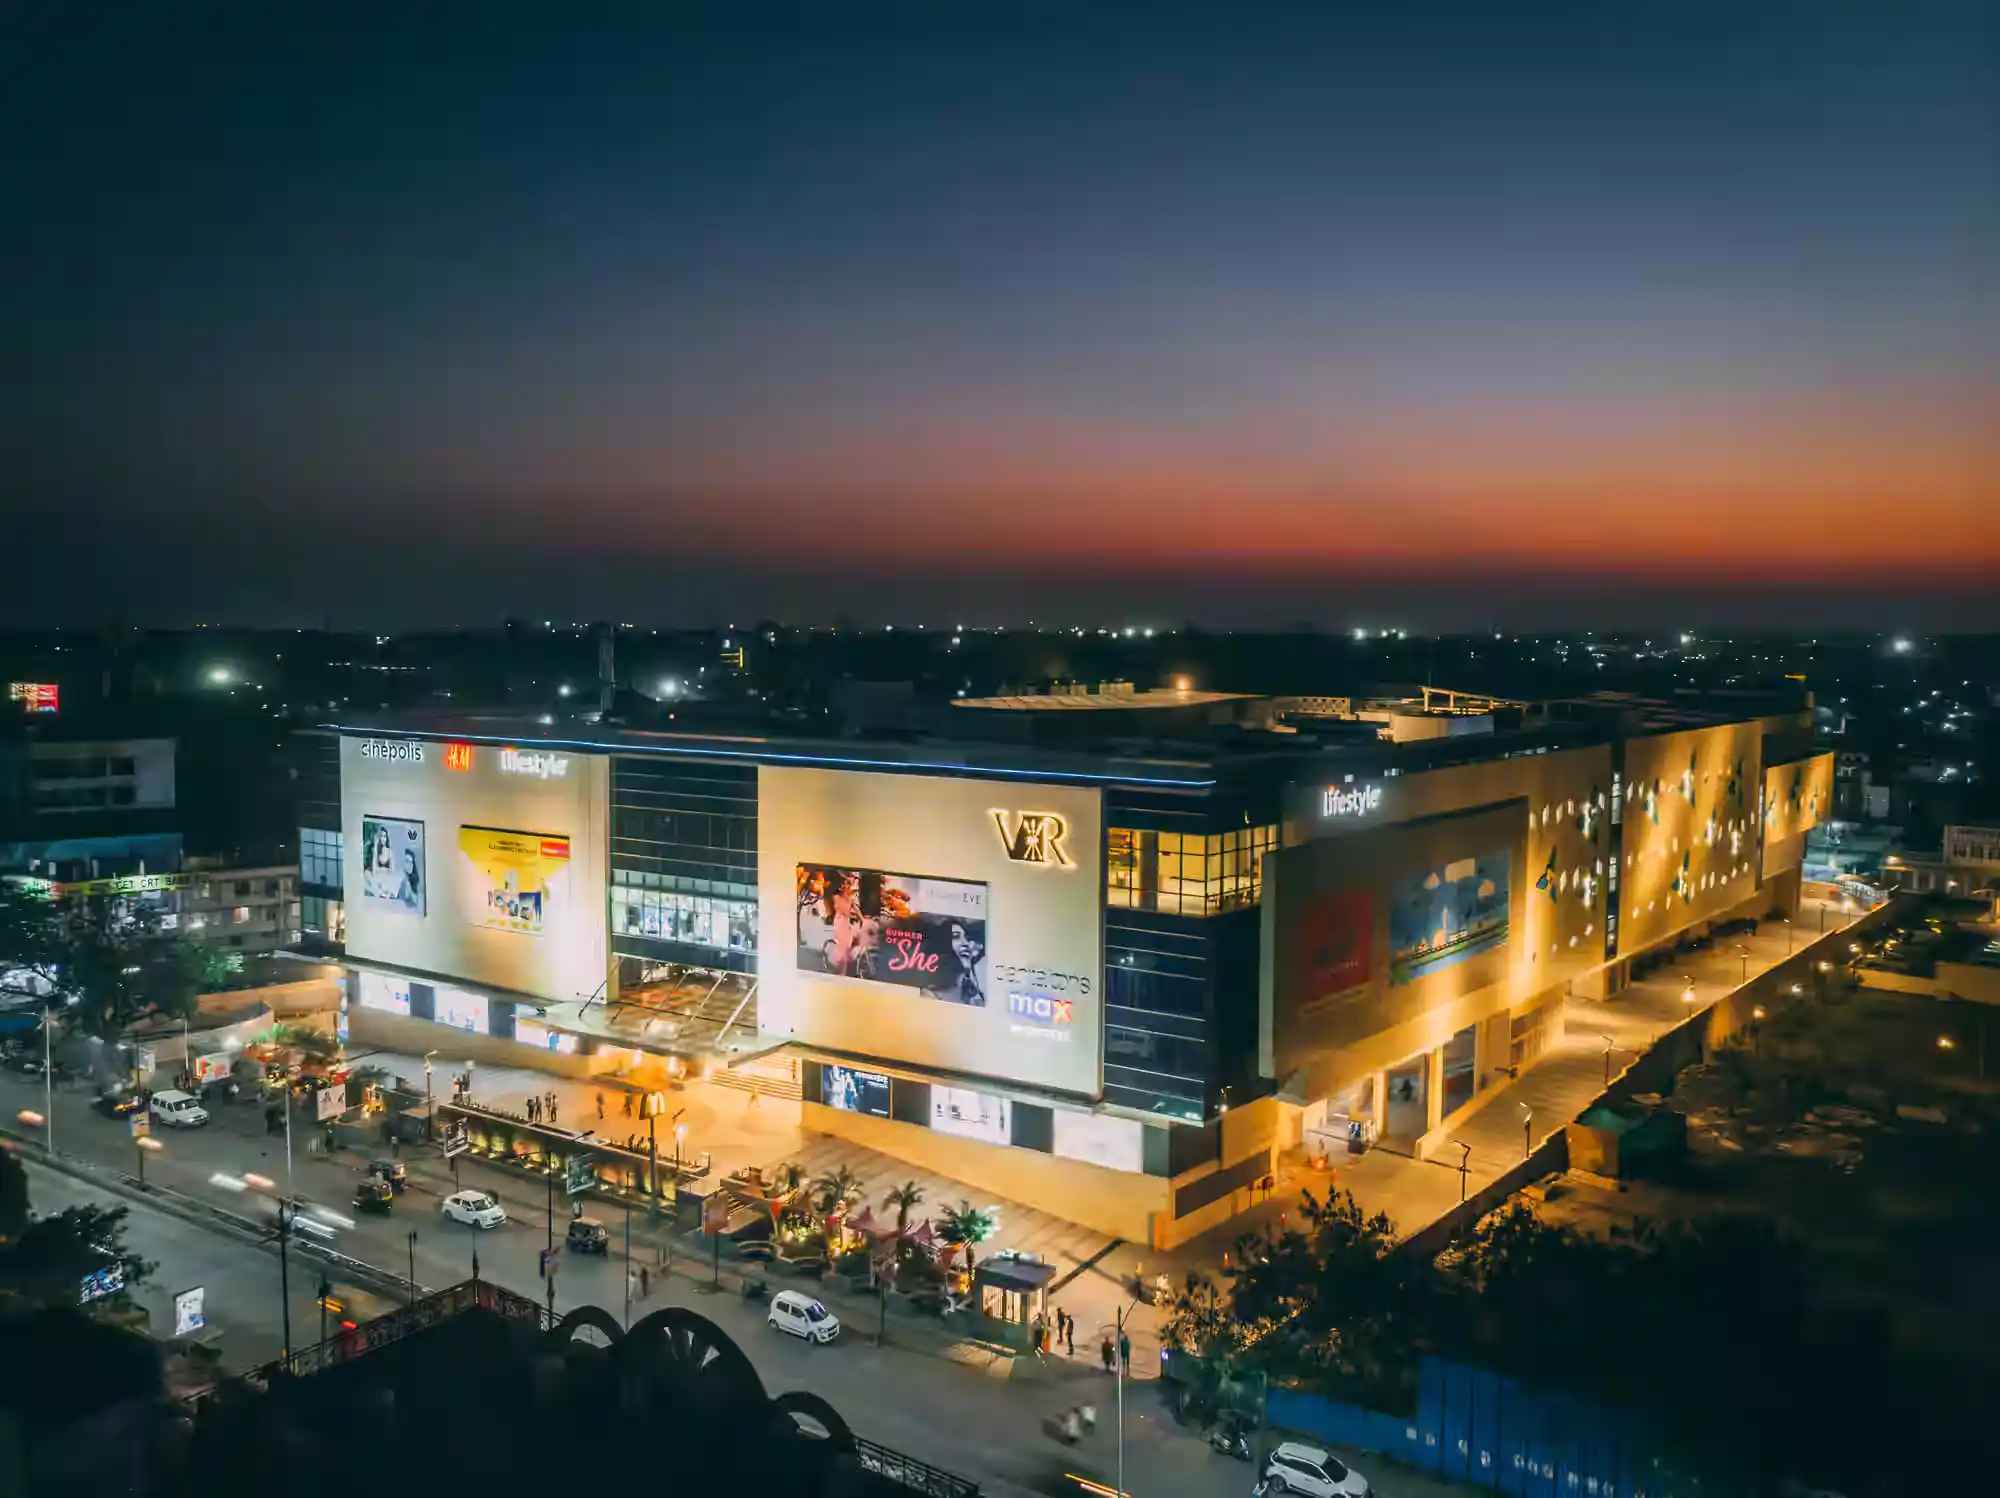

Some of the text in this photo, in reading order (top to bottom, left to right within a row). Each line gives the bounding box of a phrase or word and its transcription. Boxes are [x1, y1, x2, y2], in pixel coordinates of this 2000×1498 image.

[1321, 784, 1382, 817] lifestyle
[886, 928, 923, 941] SUMMER
[888, 938, 940, 972] She
[1009, 994, 1073, 1024] max
